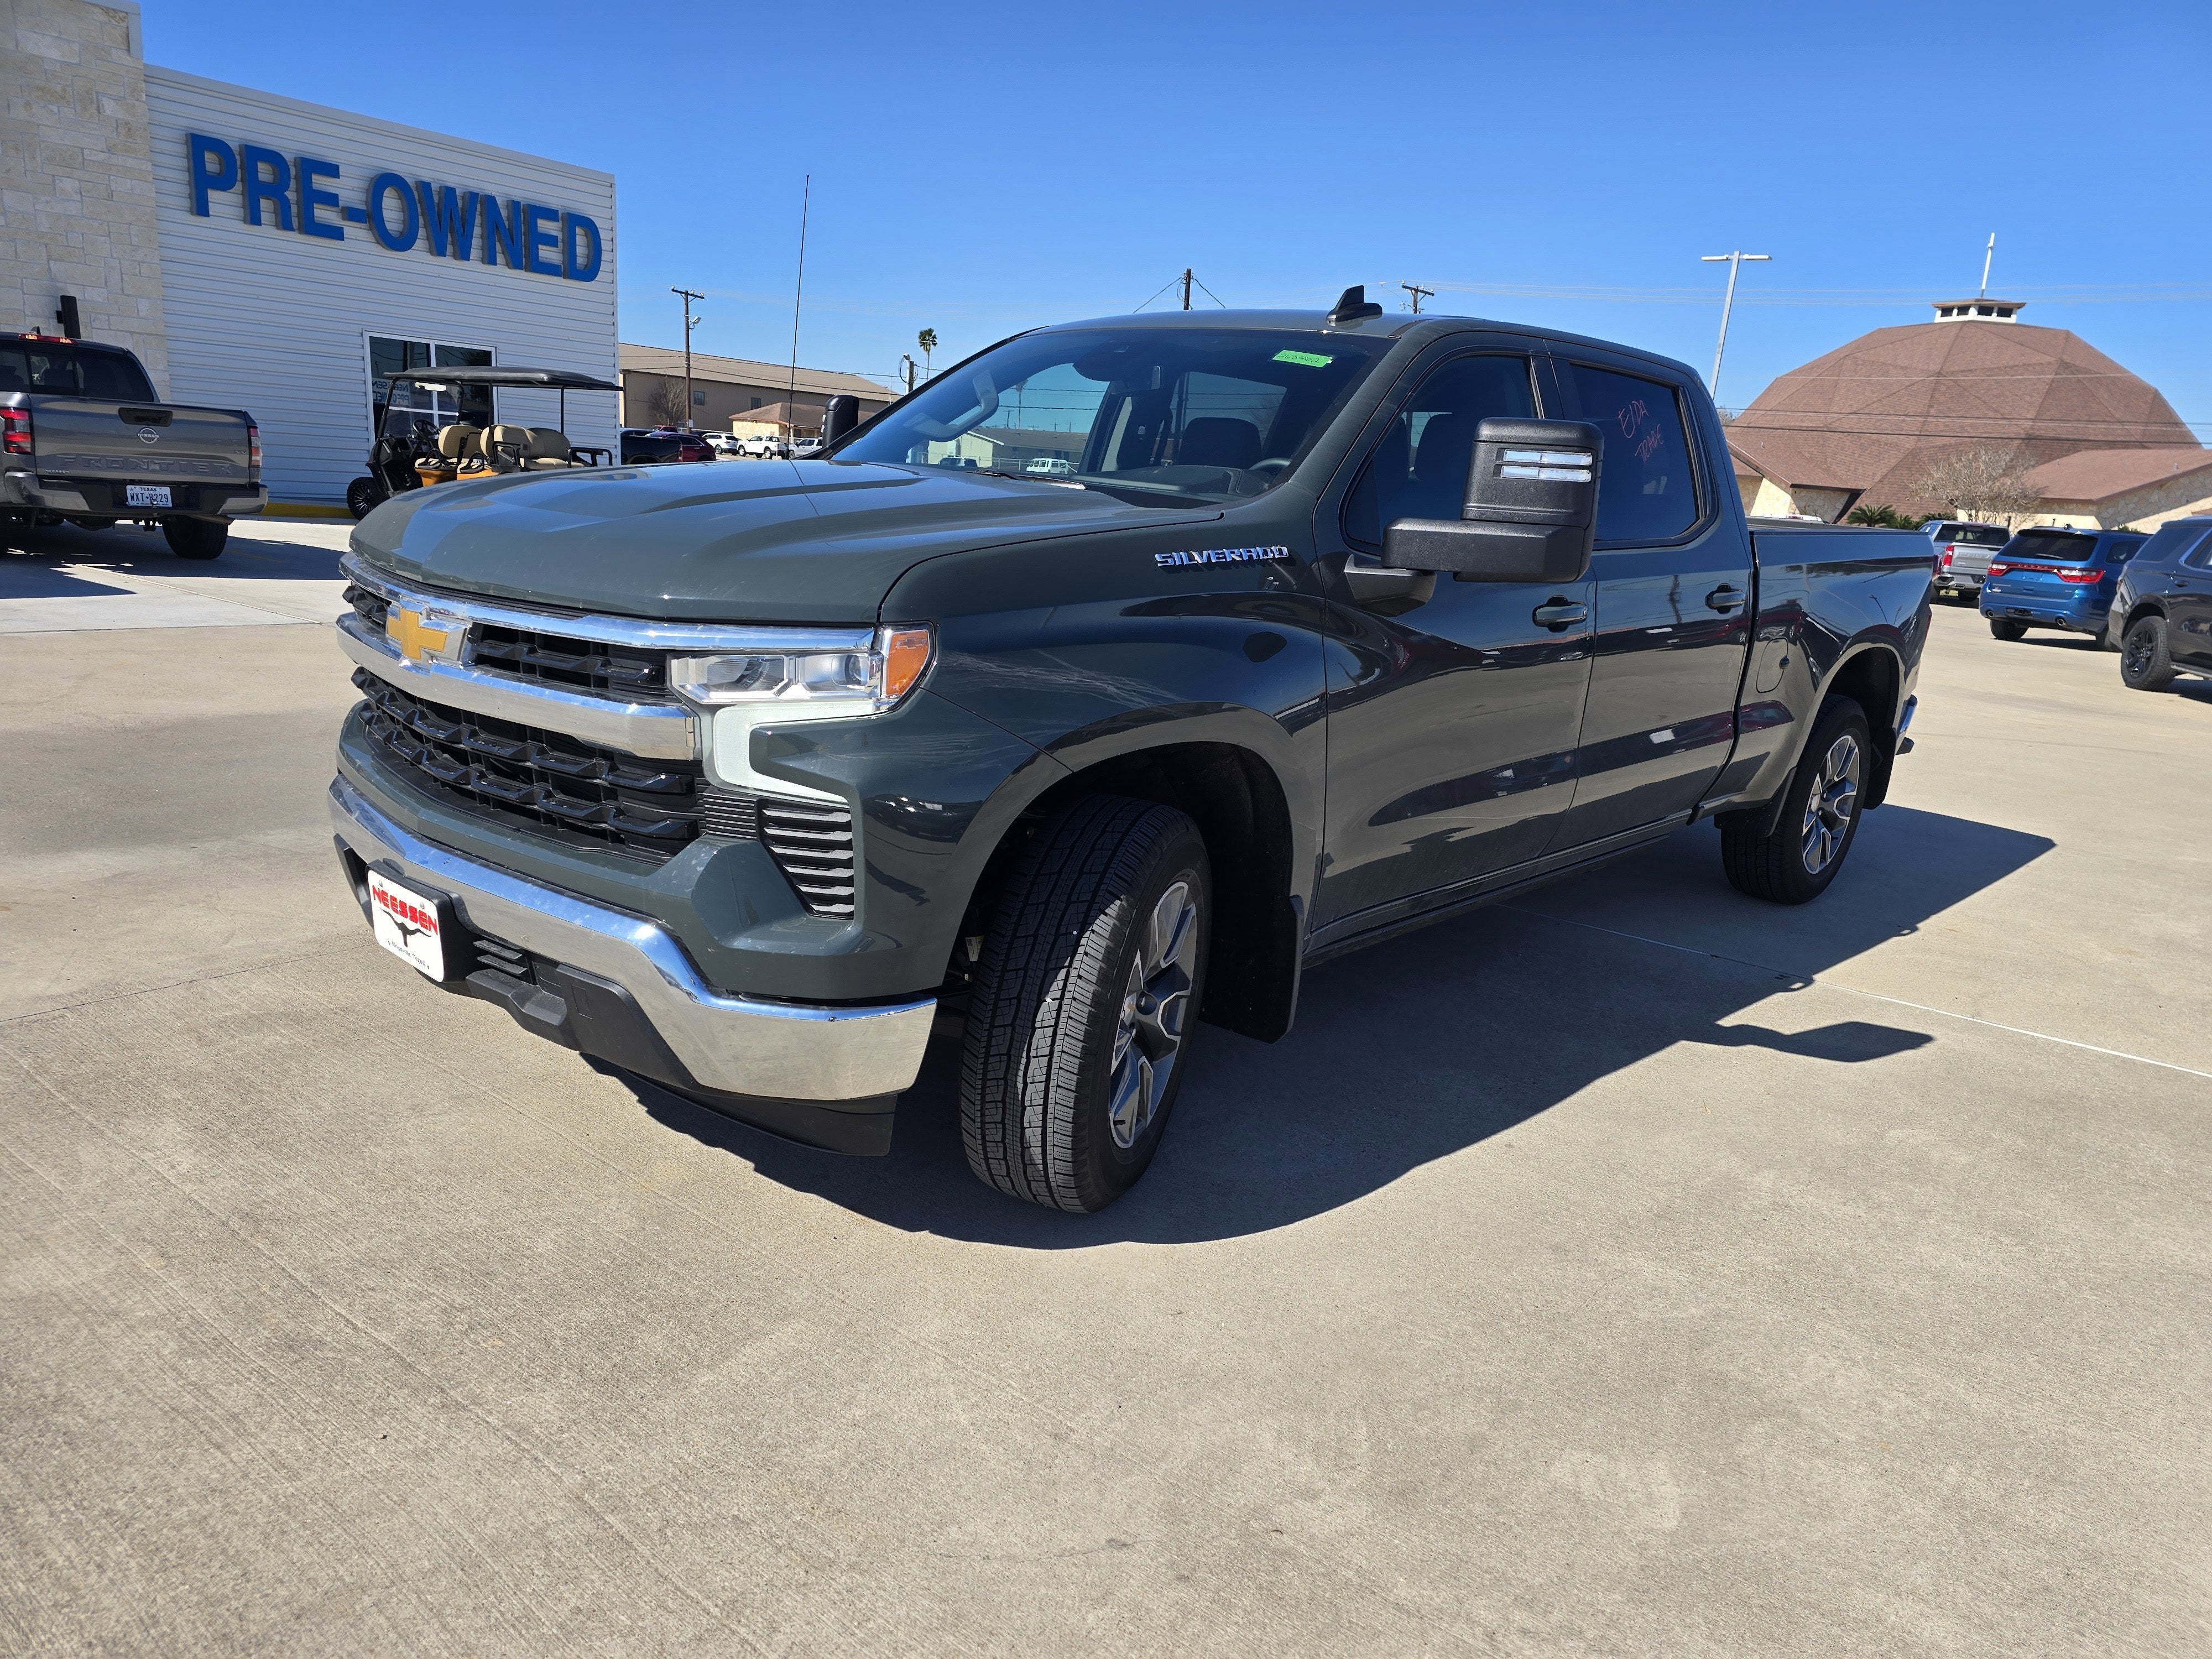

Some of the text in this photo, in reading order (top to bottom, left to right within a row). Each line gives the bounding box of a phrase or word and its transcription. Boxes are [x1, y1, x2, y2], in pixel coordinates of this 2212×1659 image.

[186, 132, 602, 282] PRE-OWNED
[56, 455, 232, 475] FRONTIER
[1154, 545, 1289, 567] SILVERADO
[372, 884, 438, 935] NEESSEN
